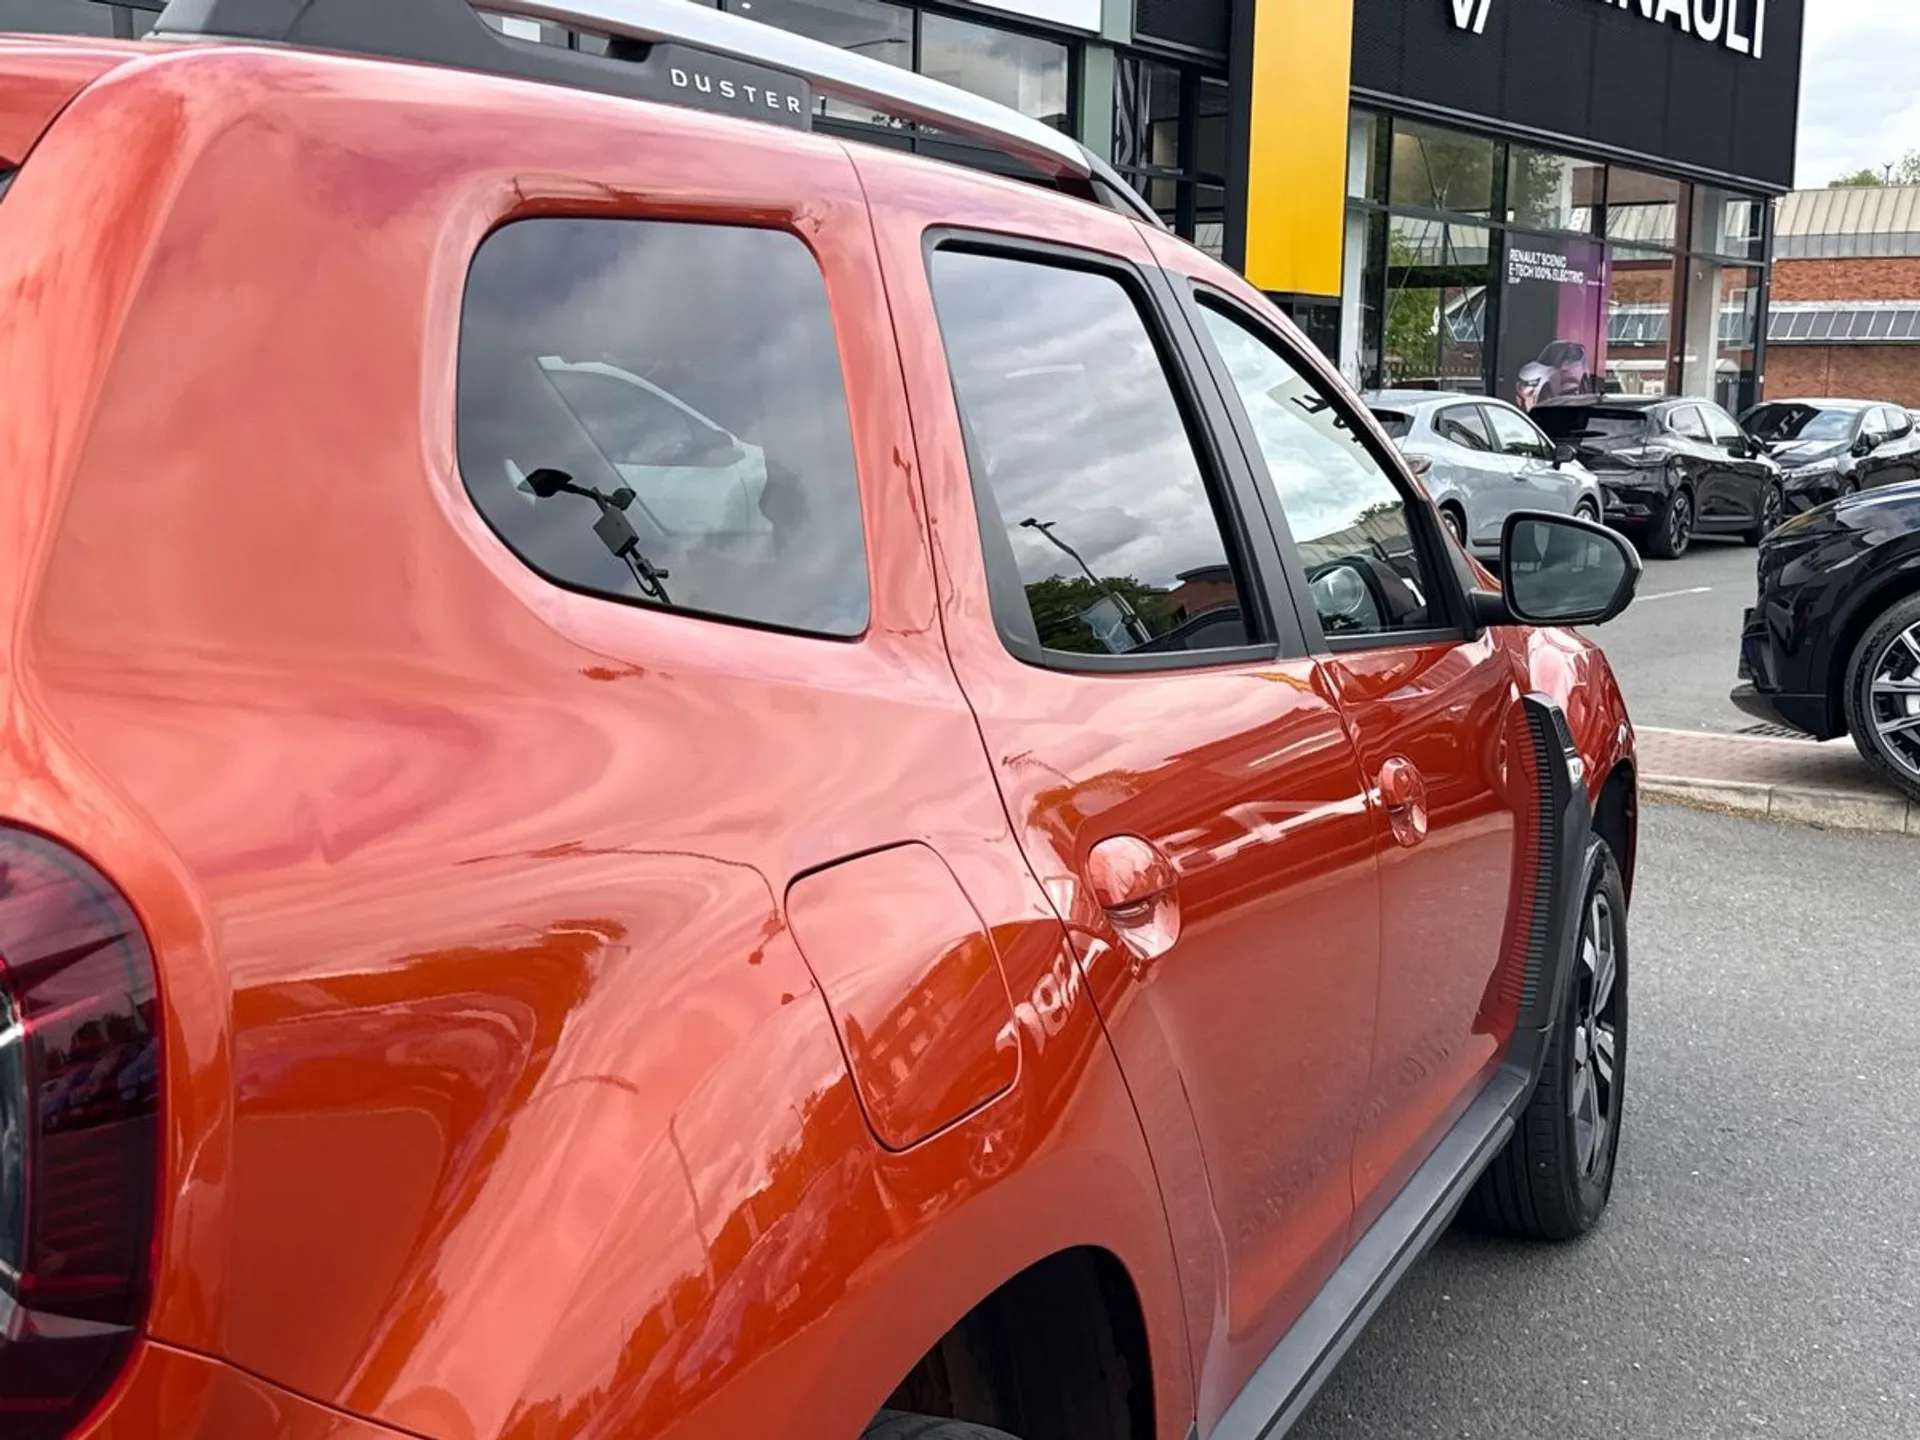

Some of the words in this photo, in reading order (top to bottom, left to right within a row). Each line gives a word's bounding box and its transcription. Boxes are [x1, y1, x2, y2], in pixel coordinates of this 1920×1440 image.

[1602, 0, 1764, 59] AULT
[670, 68, 801, 113] DUSTER
[1509, 248, 1541, 264] RENAULT
[1508, 262, 1535, 278] E-TECH
[1552, 267, 1584, 284] ELECTRIC
